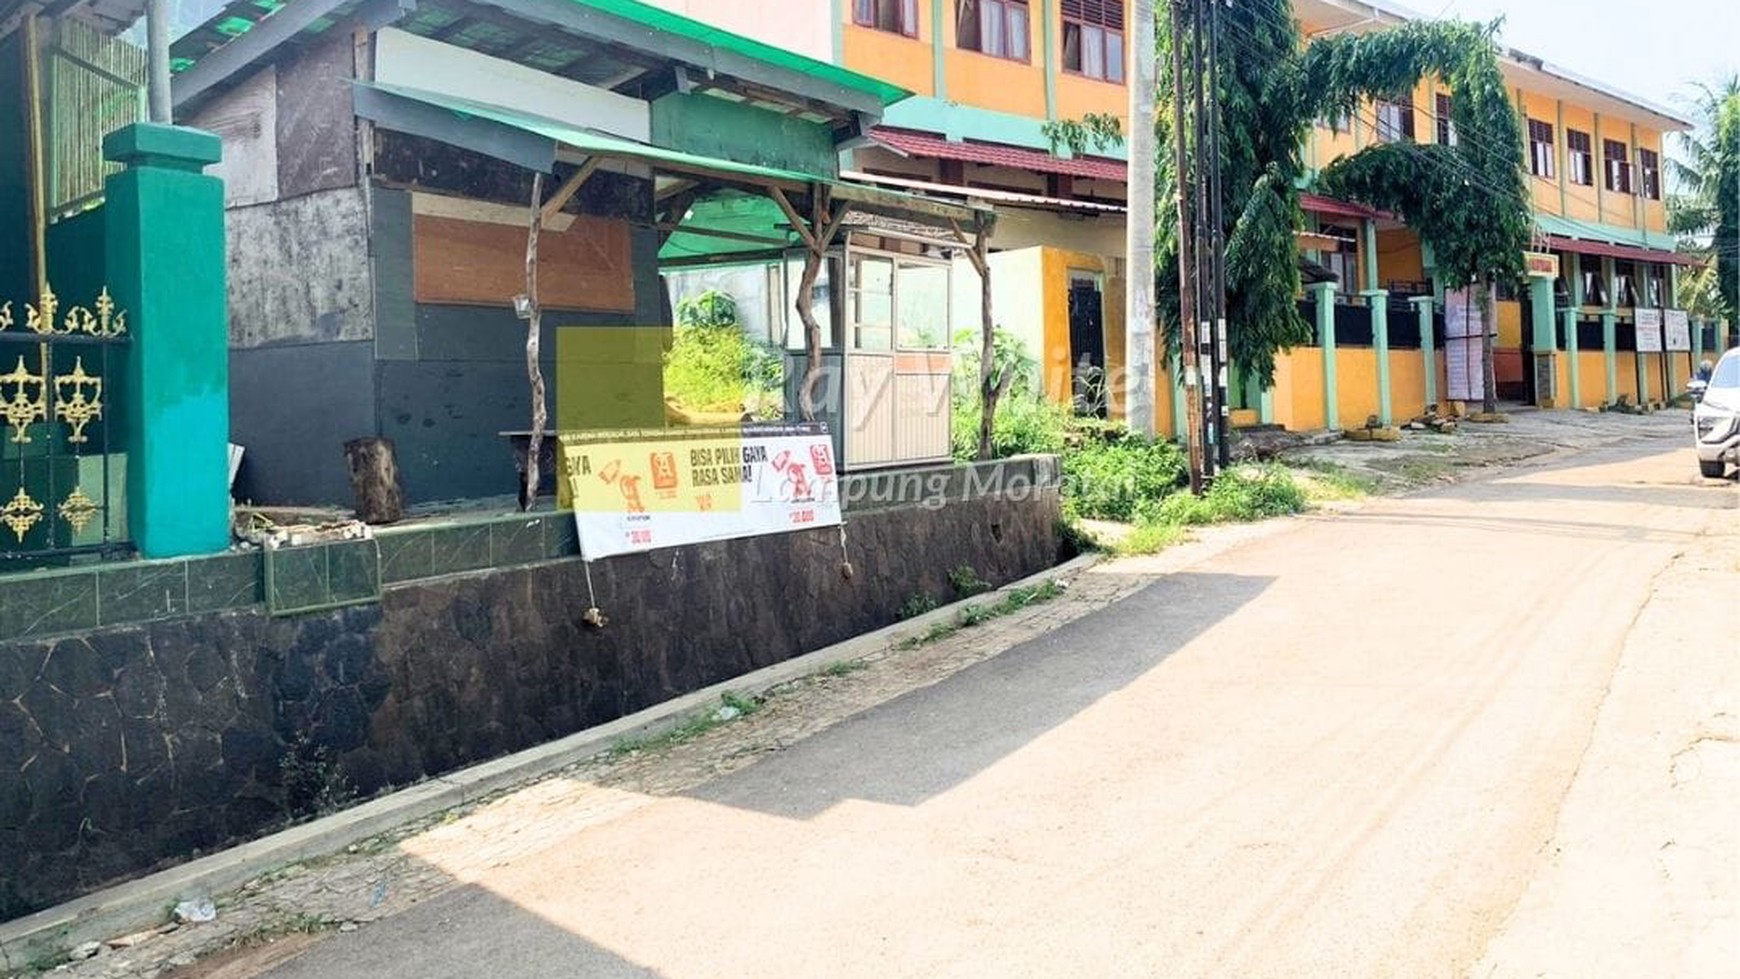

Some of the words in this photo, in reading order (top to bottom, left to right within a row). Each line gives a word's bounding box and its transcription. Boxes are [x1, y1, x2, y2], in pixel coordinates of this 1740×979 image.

[690, 448, 713, 466] BISA
[742, 445, 768, 463] GAYA
[692, 467, 719, 487] RASA
